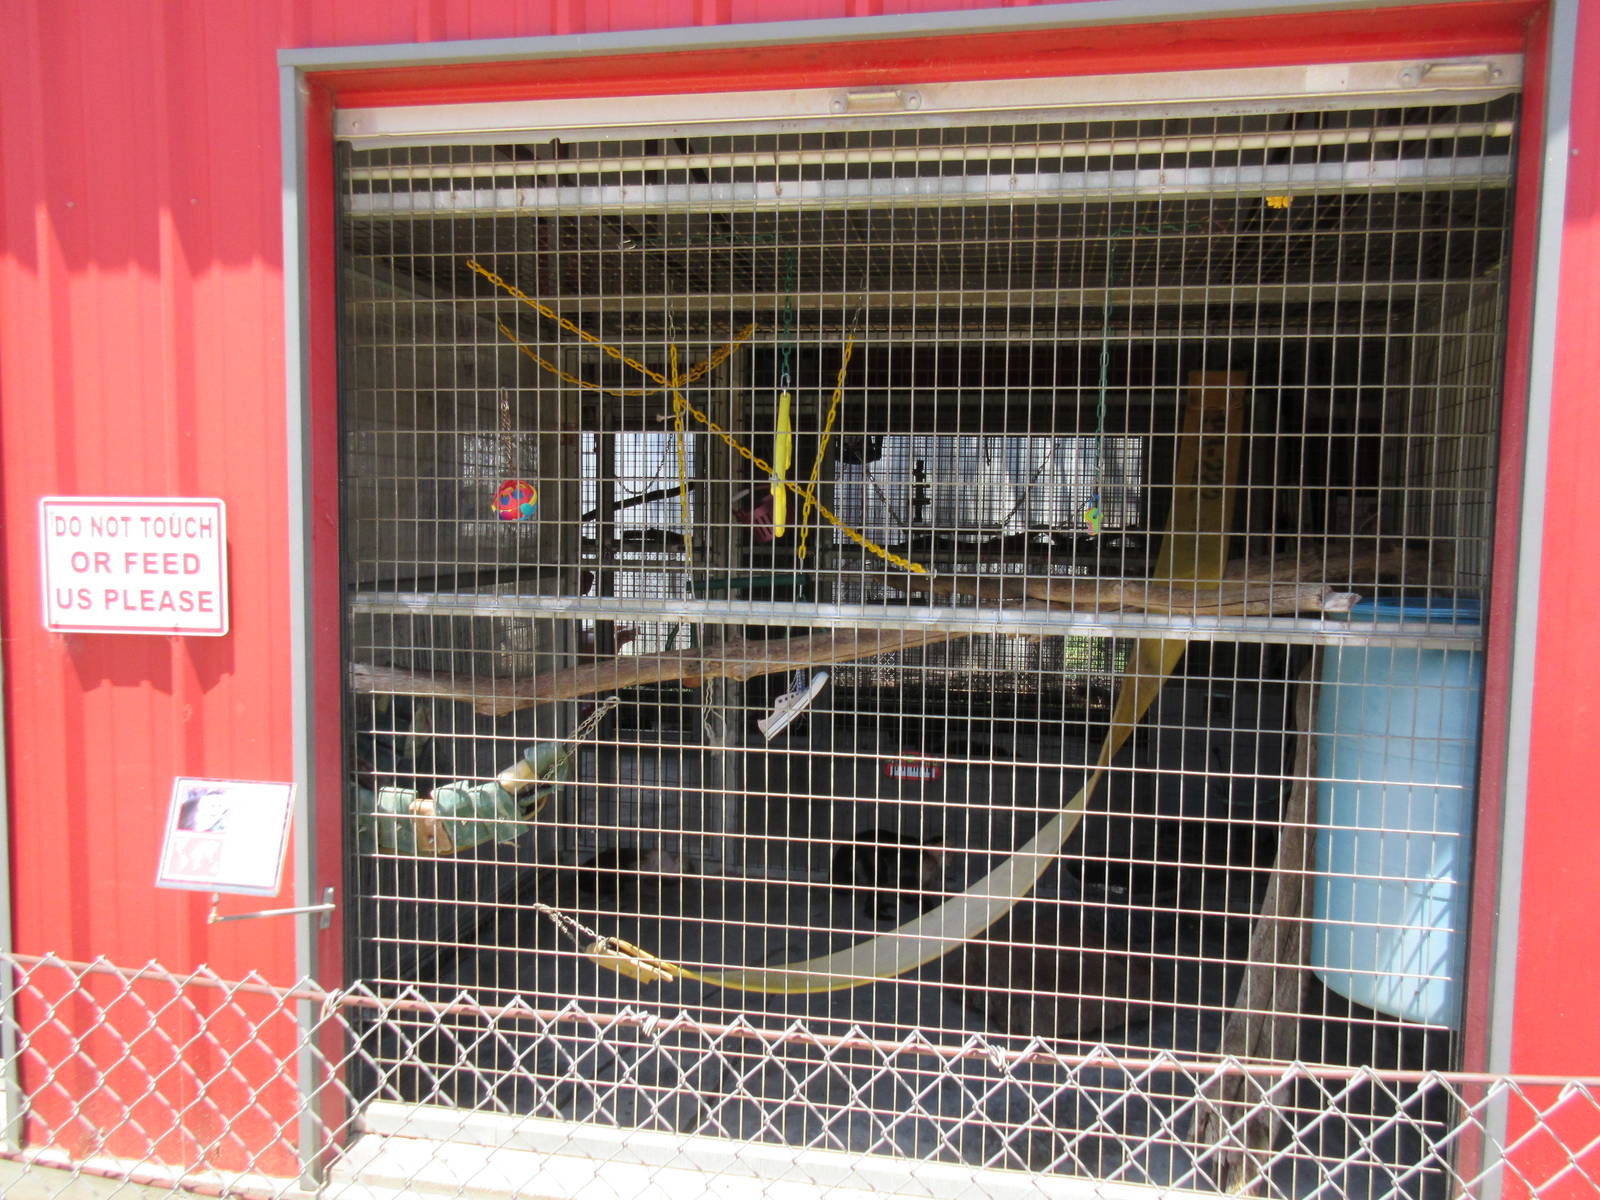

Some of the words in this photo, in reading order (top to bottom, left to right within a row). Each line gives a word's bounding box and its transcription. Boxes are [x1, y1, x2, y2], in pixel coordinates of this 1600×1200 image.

[55, 516, 82, 537] DO
[91, 516, 131, 538] NOT
[140, 516, 213, 539] TOUCH
[71, 551, 111, 574] OR
[124, 552, 201, 575] FEED
[56, 588, 92, 610] US
[104, 588, 214, 613] PLEASE
